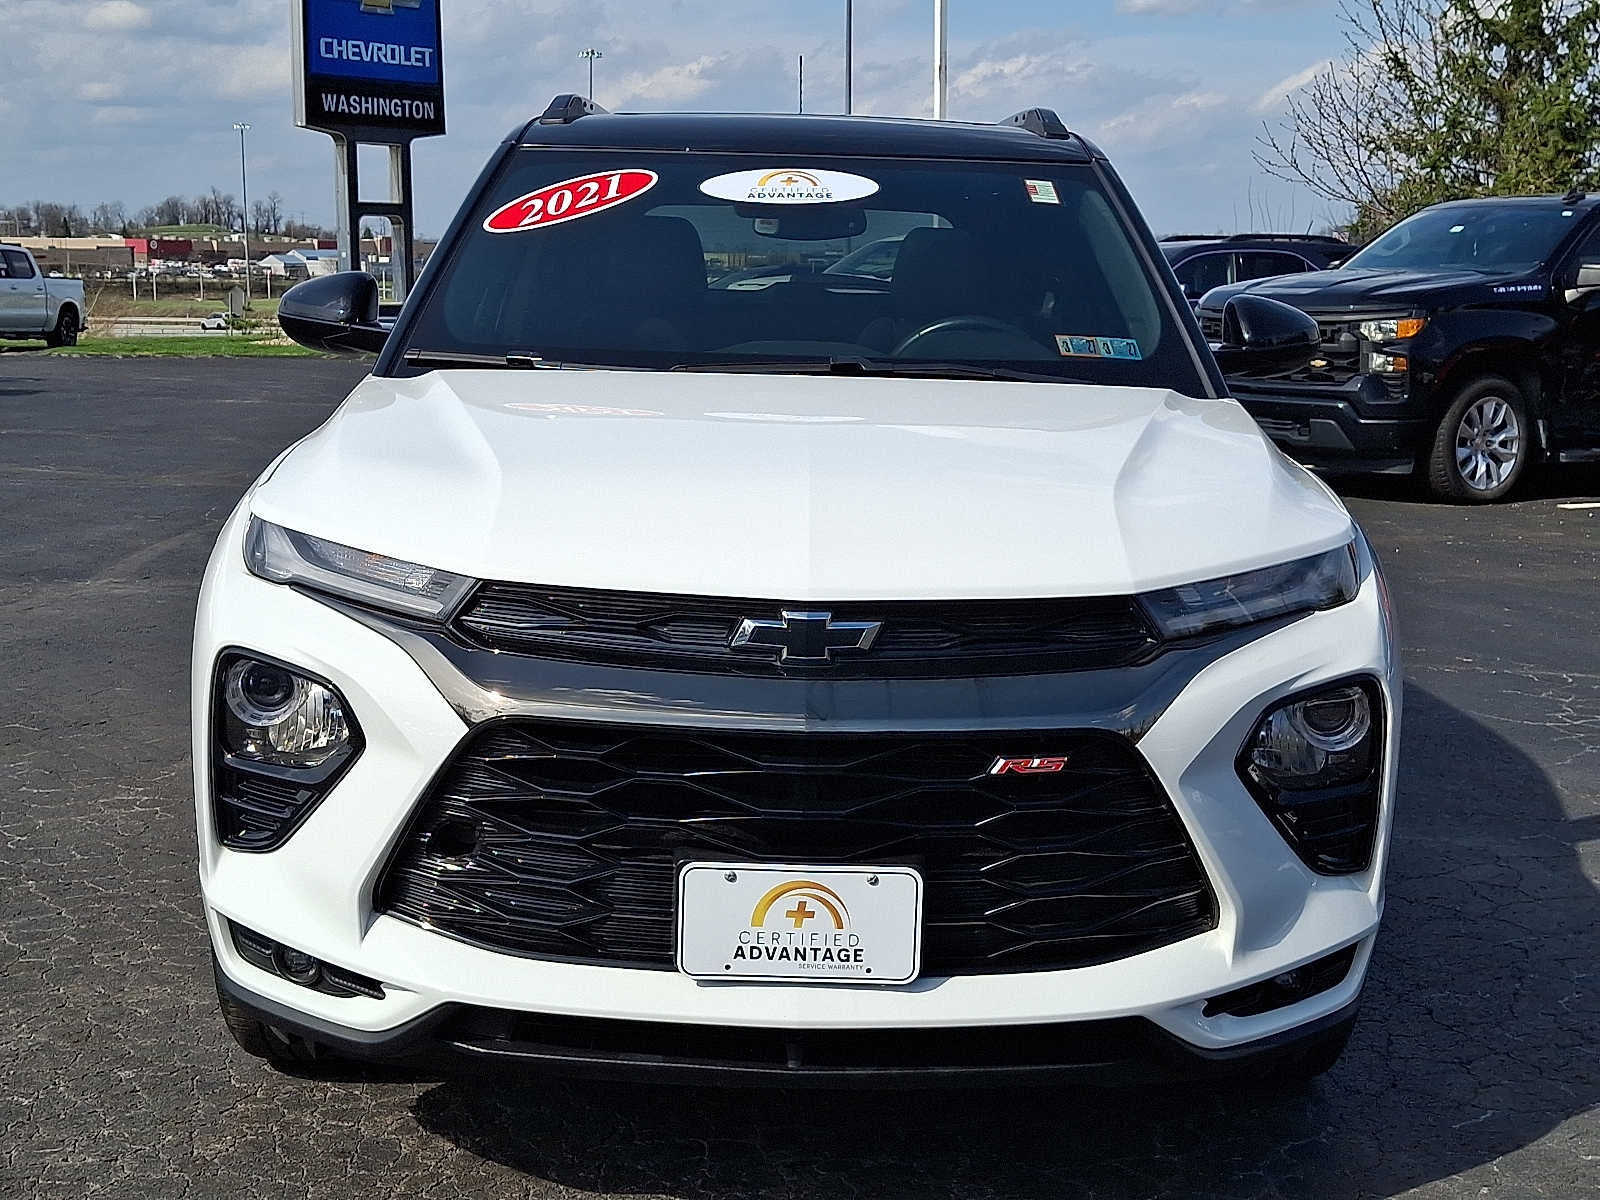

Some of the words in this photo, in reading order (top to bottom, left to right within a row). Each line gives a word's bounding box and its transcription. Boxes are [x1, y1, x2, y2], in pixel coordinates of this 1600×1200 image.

[319, 37, 433, 67] CHEVROLET
[321, 92, 435, 120] WASHINGTON
[518, 173, 622, 227] 2021
[990, 757, 1068, 774] RS
[738, 930, 860, 947] CERTIFIED
[733, 945, 864, 963] ADVANTAGE
[827, 963, 864, 971] WARRANTY
